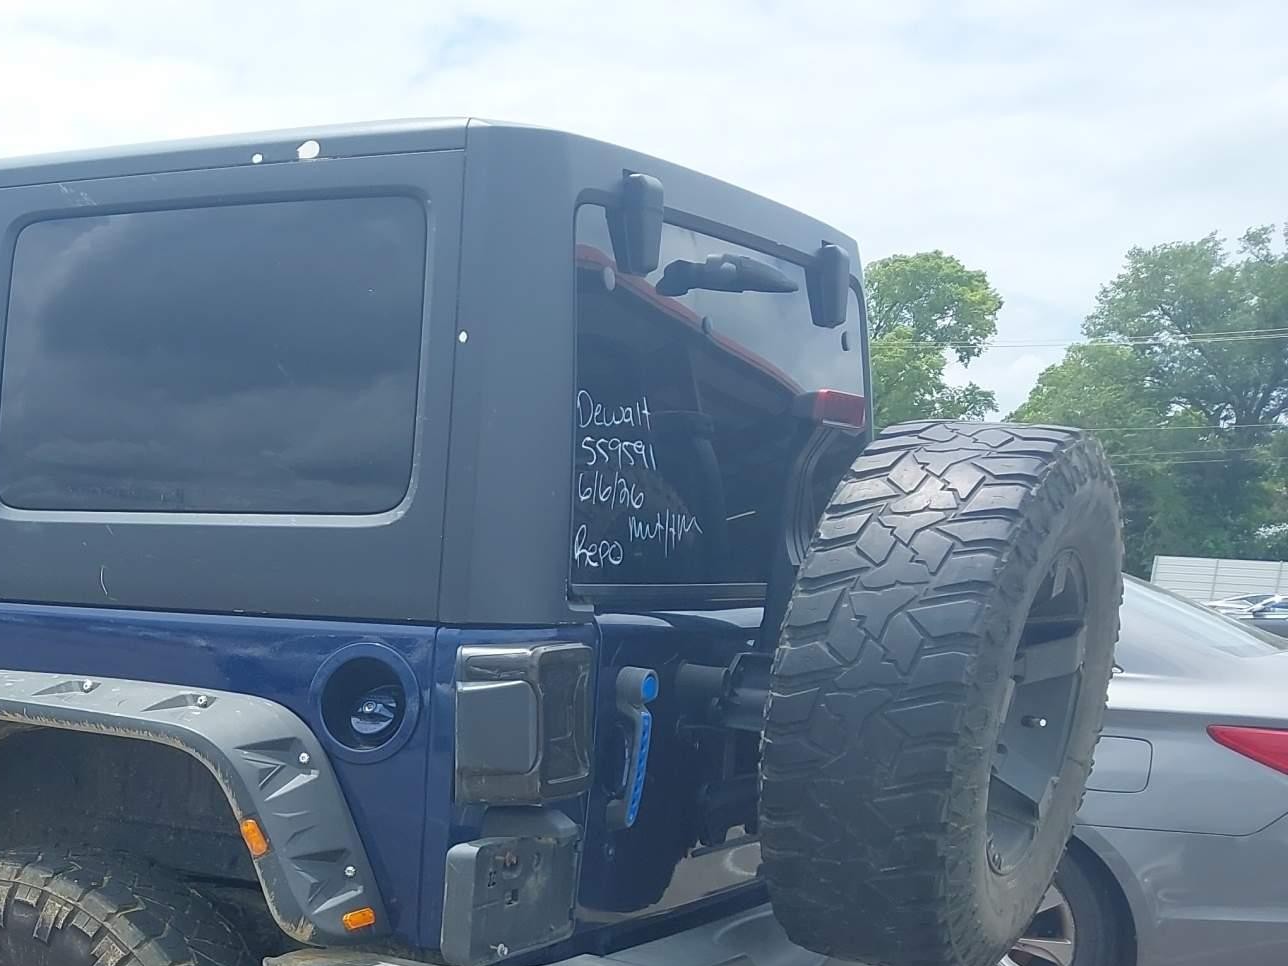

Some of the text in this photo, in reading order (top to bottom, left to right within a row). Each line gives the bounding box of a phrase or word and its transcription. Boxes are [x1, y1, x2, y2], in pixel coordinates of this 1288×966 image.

[582, 436, 656, 470] 559591
[578, 470, 644, 509] 6/6/26
[574, 524, 623, 569] Repo
